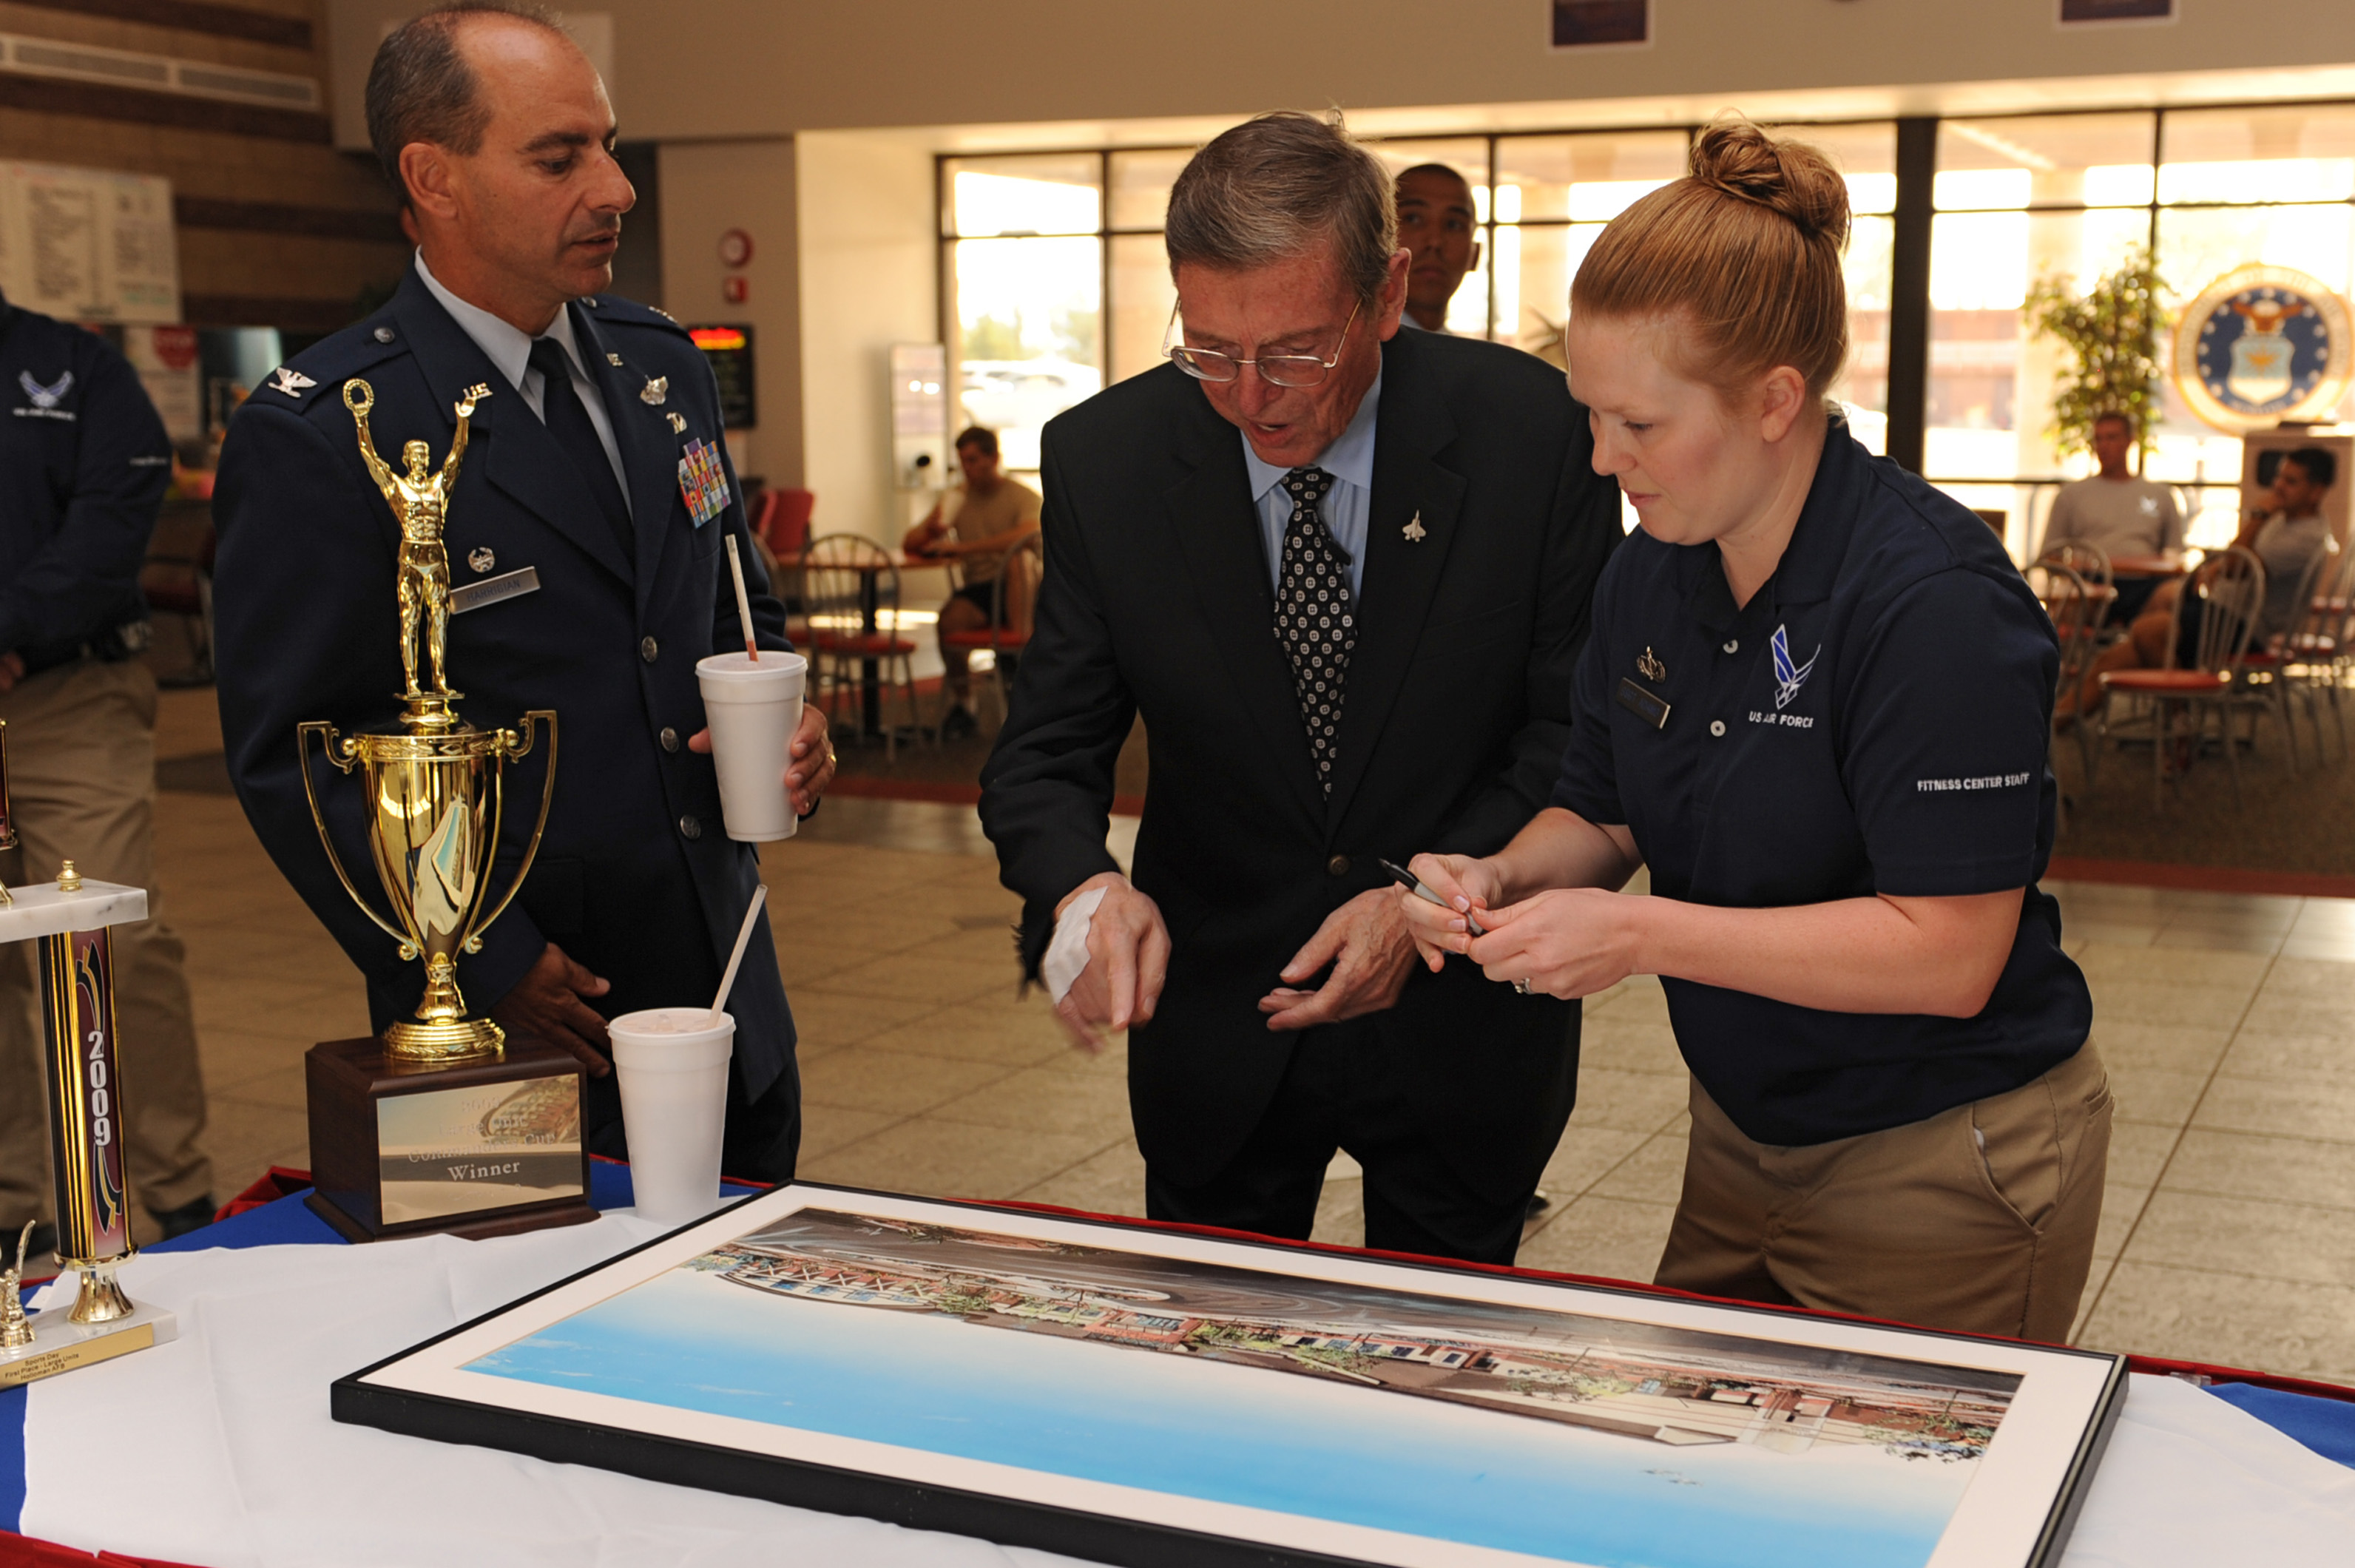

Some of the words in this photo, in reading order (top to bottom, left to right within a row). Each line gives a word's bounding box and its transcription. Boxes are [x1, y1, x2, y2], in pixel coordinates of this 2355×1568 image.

[1748, 710, 1762, 723] US
[1763, 712, 1777, 724] AIR
[1917, 779, 1962, 792] FITNESS
[1963, 774, 2003, 791] CENTER
[2004, 771, 2030, 787] STAFF
[87, 1030, 111, 1146] 2009
[524, 1132, 555, 1146] Cup
[447, 1161, 521, 1182] Winner
[5, 1370, 21, 1379] First
[21, 1365, 39, 1375] Place
[44, 1359, 62, 1368] Large
[62, 1353, 79, 1362] Units
[25, 1356, 46, 1367] Sports
[47, 1352, 60, 1361] Day
[21, 1368, 50, 1381] Holloman
[52, 1362, 65, 1372] AFB
